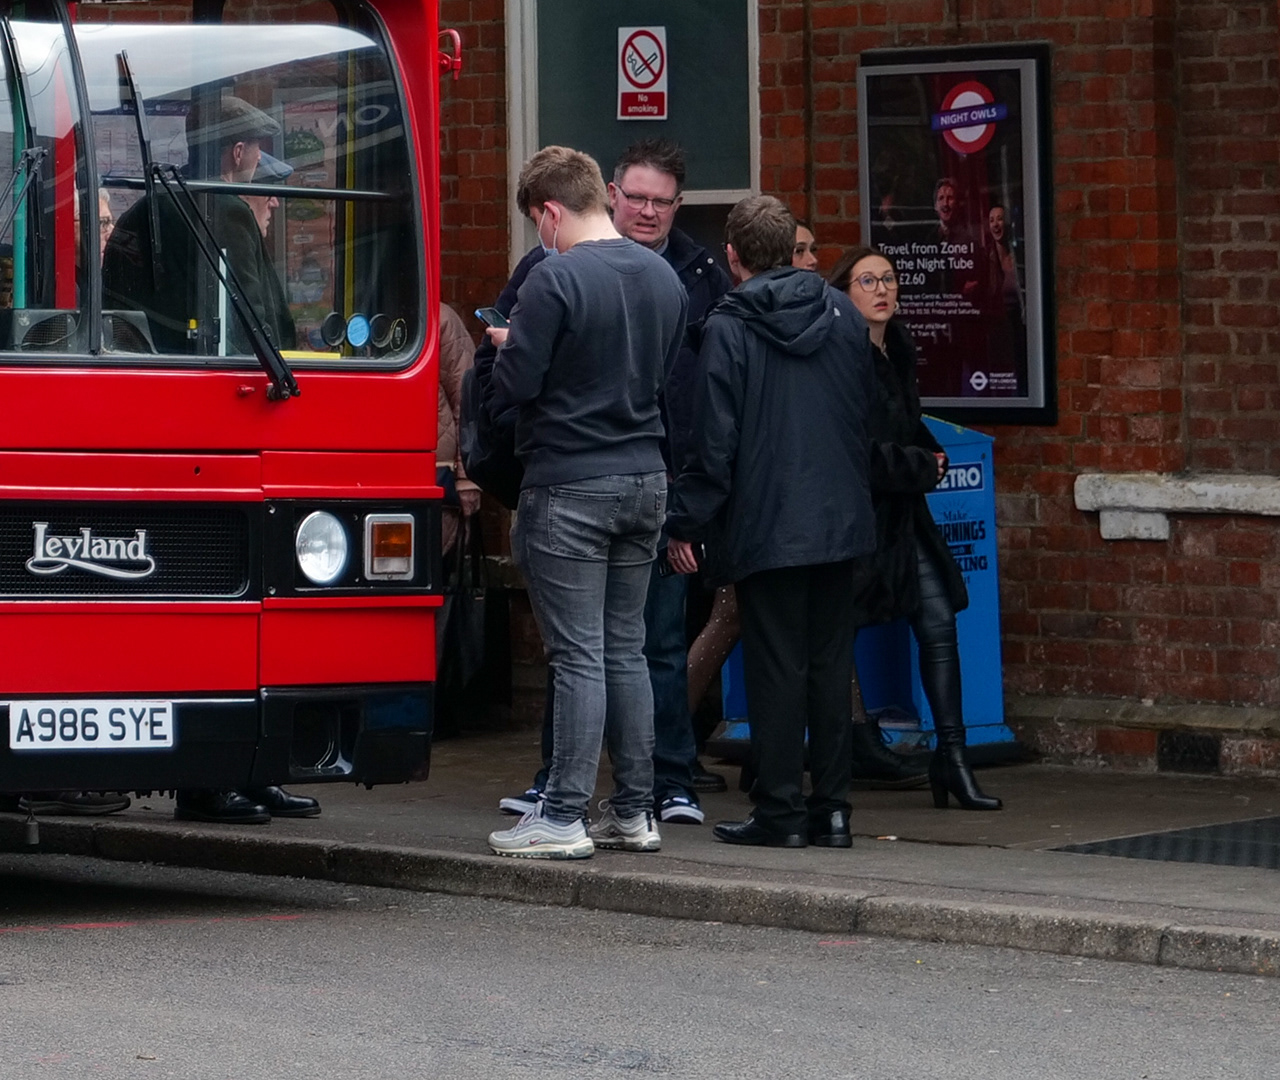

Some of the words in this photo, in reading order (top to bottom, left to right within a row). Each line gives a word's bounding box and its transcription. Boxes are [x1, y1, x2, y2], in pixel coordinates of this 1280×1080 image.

[637, 93, 648, 102] No
[627, 104, 658, 114] smoking
[940, 112, 969, 126] NIGHT
[970, 107, 997, 121] OWLS
[878, 242, 909, 255] Travel
[911, 243, 938, 254] from
[940, 242, 968, 254] Zone
[896, 258, 914, 270] the
[916, 257, 946, 273] Night
[947, 257, 974, 270] Tube
[899, 272, 926, 285] £2.60
[936, 466, 981, 490] ETRO
[943, 510, 968, 522] Make
[937, 520, 986, 543] RNINGS
[26, 521, 155, 577] Leyland
[955, 555, 988, 572] KING
[16, 707, 100, 743] A986
[108, 707, 168, 742] SYE
